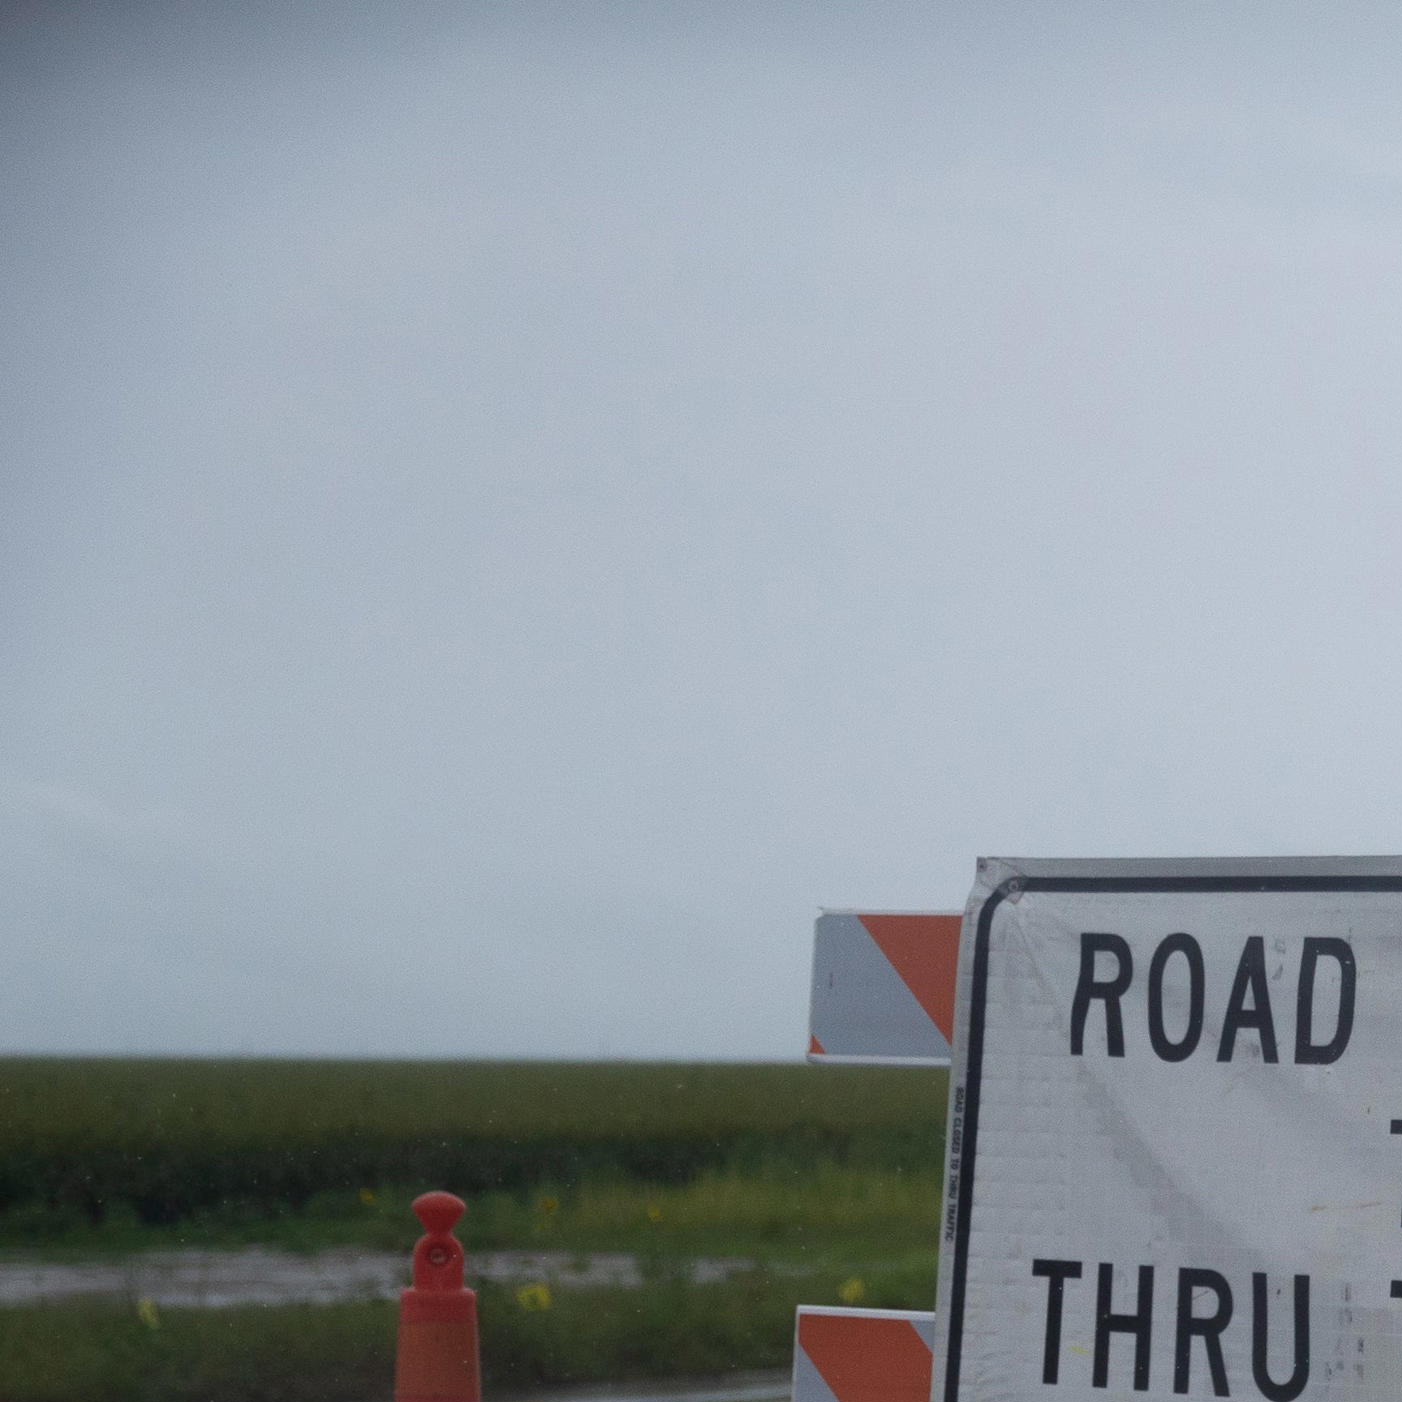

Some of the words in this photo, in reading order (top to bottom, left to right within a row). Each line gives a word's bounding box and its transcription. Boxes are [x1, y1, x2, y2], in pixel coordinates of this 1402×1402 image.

[1070, 932, 1357, 1065] ROAD
[952, 1117, 962, 1154] CLOSED
[945, 1203, 957, 1241] TRAFFIC
